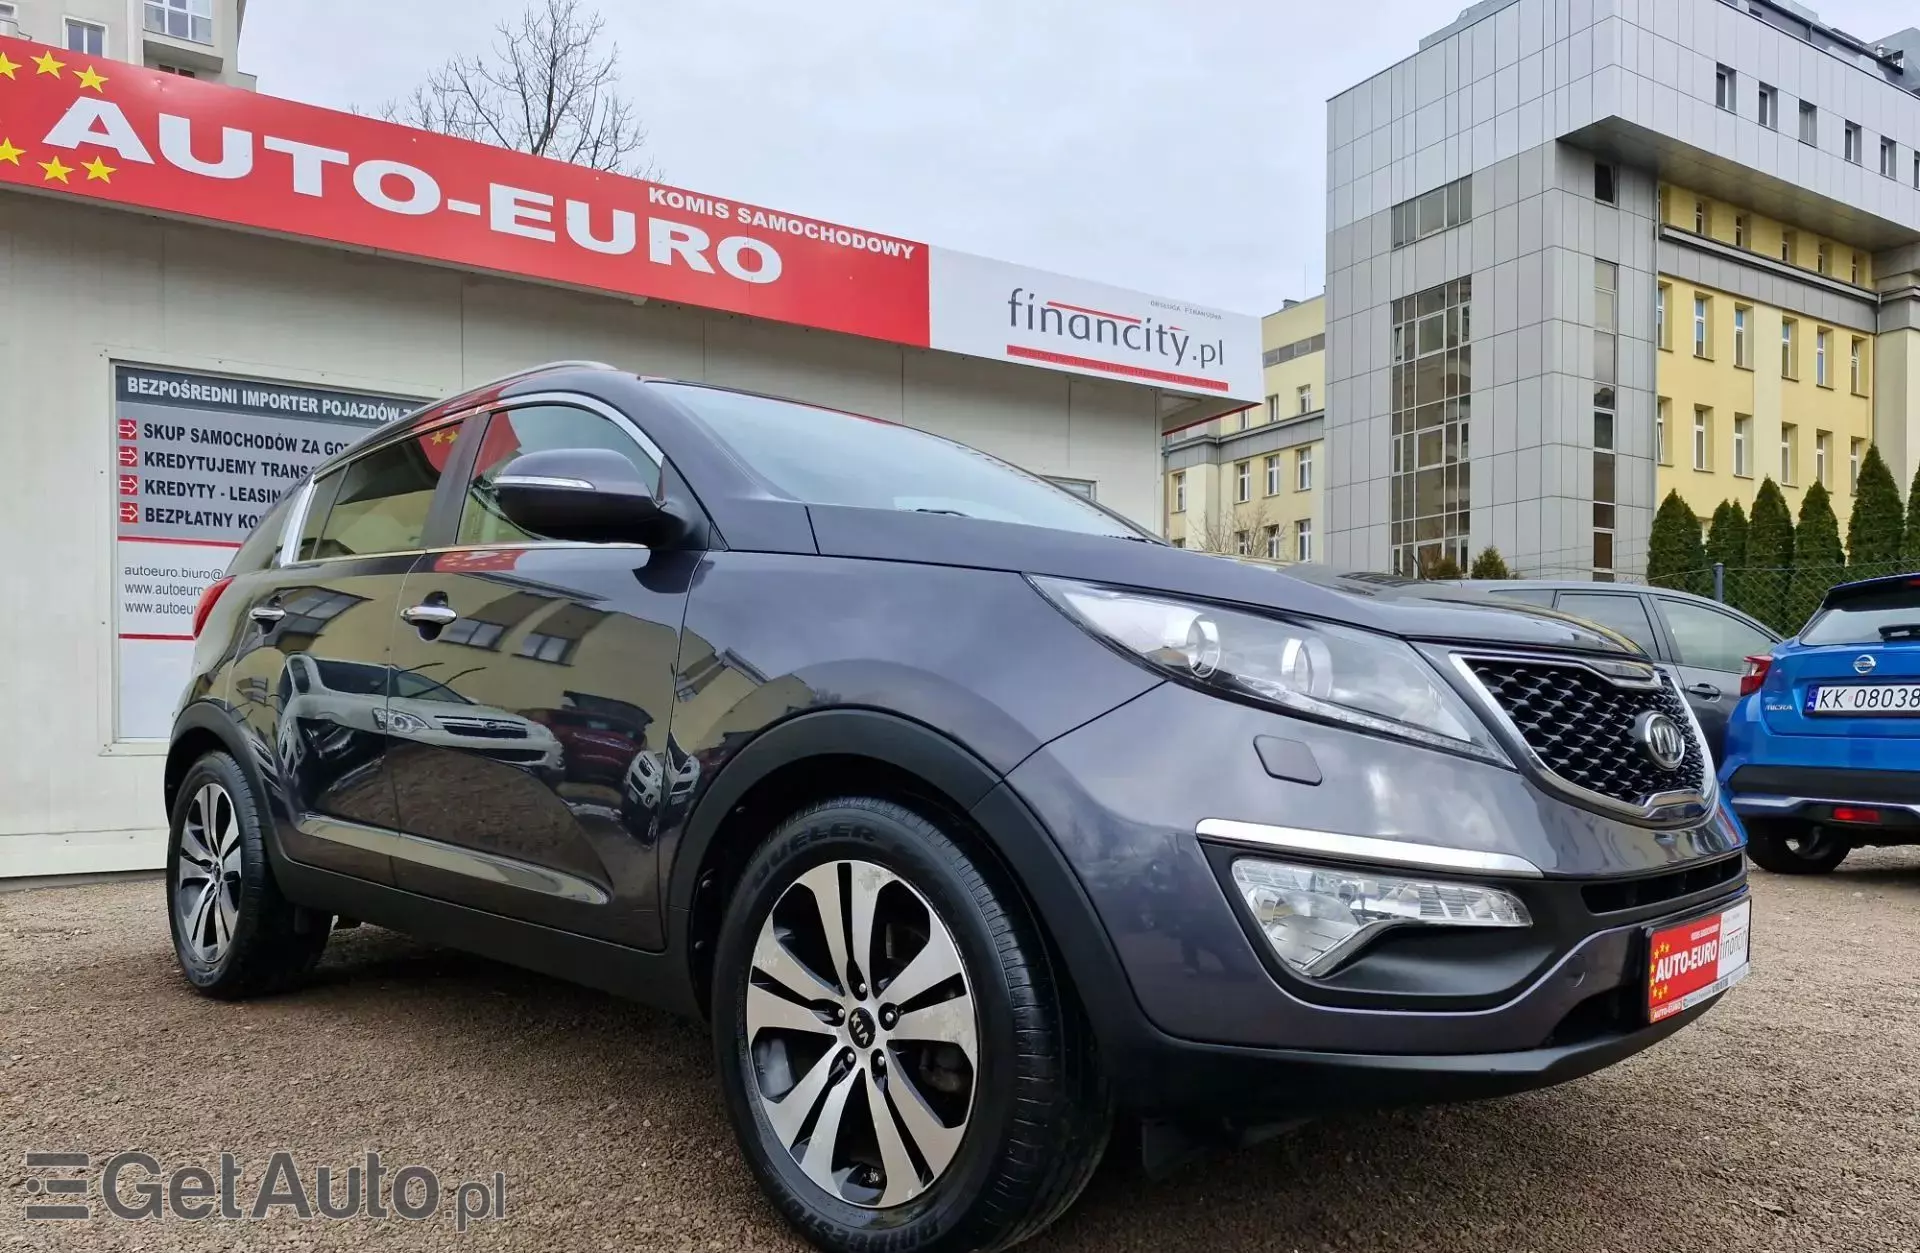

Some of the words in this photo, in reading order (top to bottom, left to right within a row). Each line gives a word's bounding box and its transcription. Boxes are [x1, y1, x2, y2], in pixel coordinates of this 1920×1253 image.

[41, 96, 783, 284] AUTO-EURO
[649, 186, 730, 220] KOMIS
[737, 206, 915, 261] SAMOCHODOWY
[1008, 287, 1224, 369] financity.pl
[127, 375, 238, 405] BEZPOŚREDNI
[242, 390, 318, 414] IMPORTER
[322, 400, 399, 421] POJAZDÓW
[144, 423, 185, 443] SKUP
[190, 427, 297, 452] SAMOCHODÓW
[301, 440, 320, 454] ZA
[144, 452, 256, 475] KREDYTUJEMY
[145, 479, 215, 499] KREDYTY
[145, 507, 233, 528] BEZPŁATNY
[124, 566, 224, 581] autoeuro.biuro@
[1819, 688, 1848, 708] KK
[1854, 687, 1920, 709] 08038
[1655, 940, 1717, 983] AUTO-EURO
[850, 1011, 869, 1046] KIA
